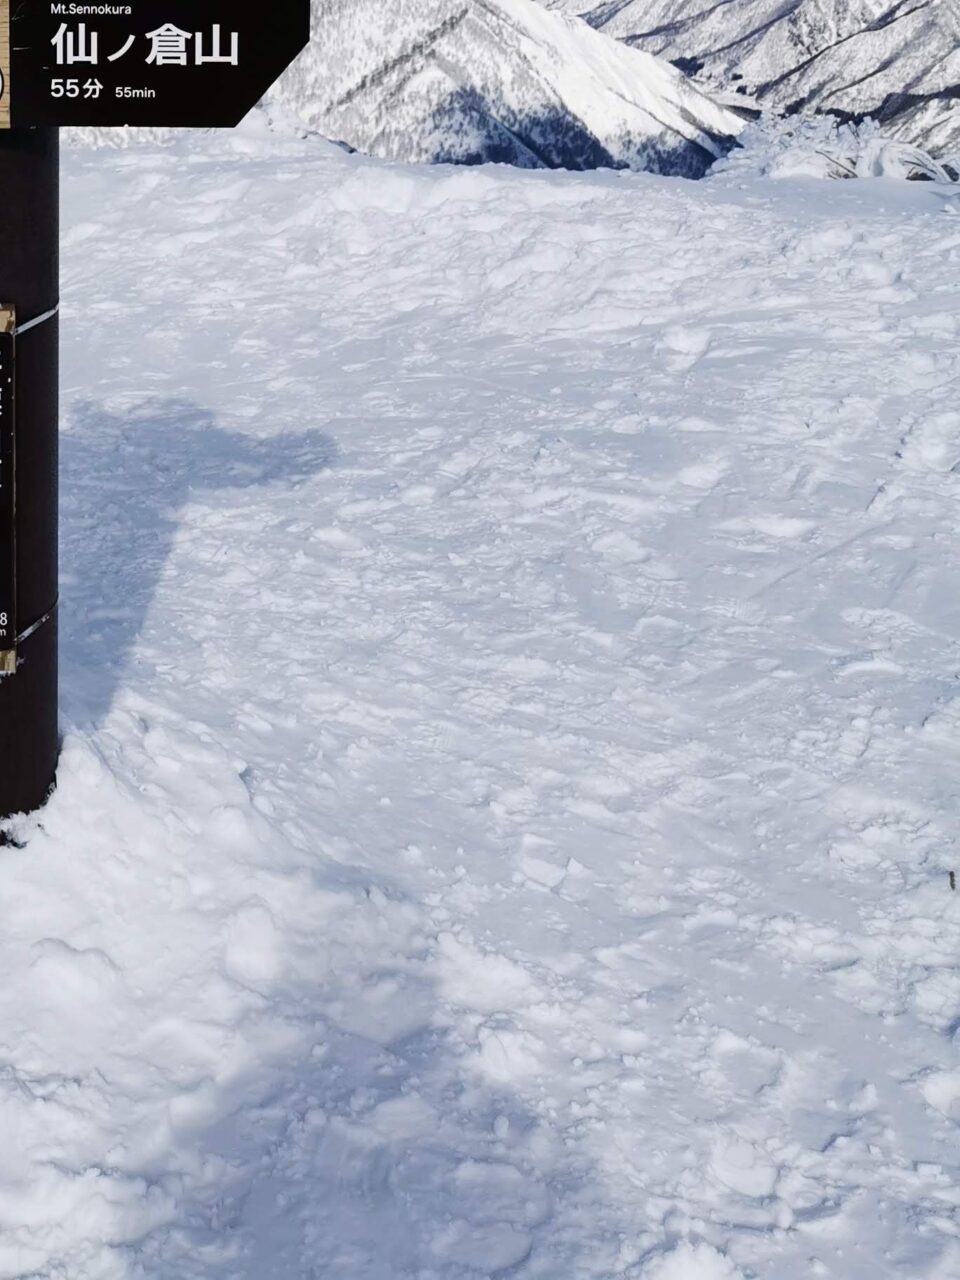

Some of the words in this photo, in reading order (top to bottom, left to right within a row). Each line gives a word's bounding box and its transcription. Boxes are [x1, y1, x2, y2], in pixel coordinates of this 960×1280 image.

[50, 2, 132, 15] Mt.Sennokura
[50, 22, 239, 66] 仙ノ倉山
[50, 78, 104, 99] 55分
[115, 86, 156, 98] 55min
